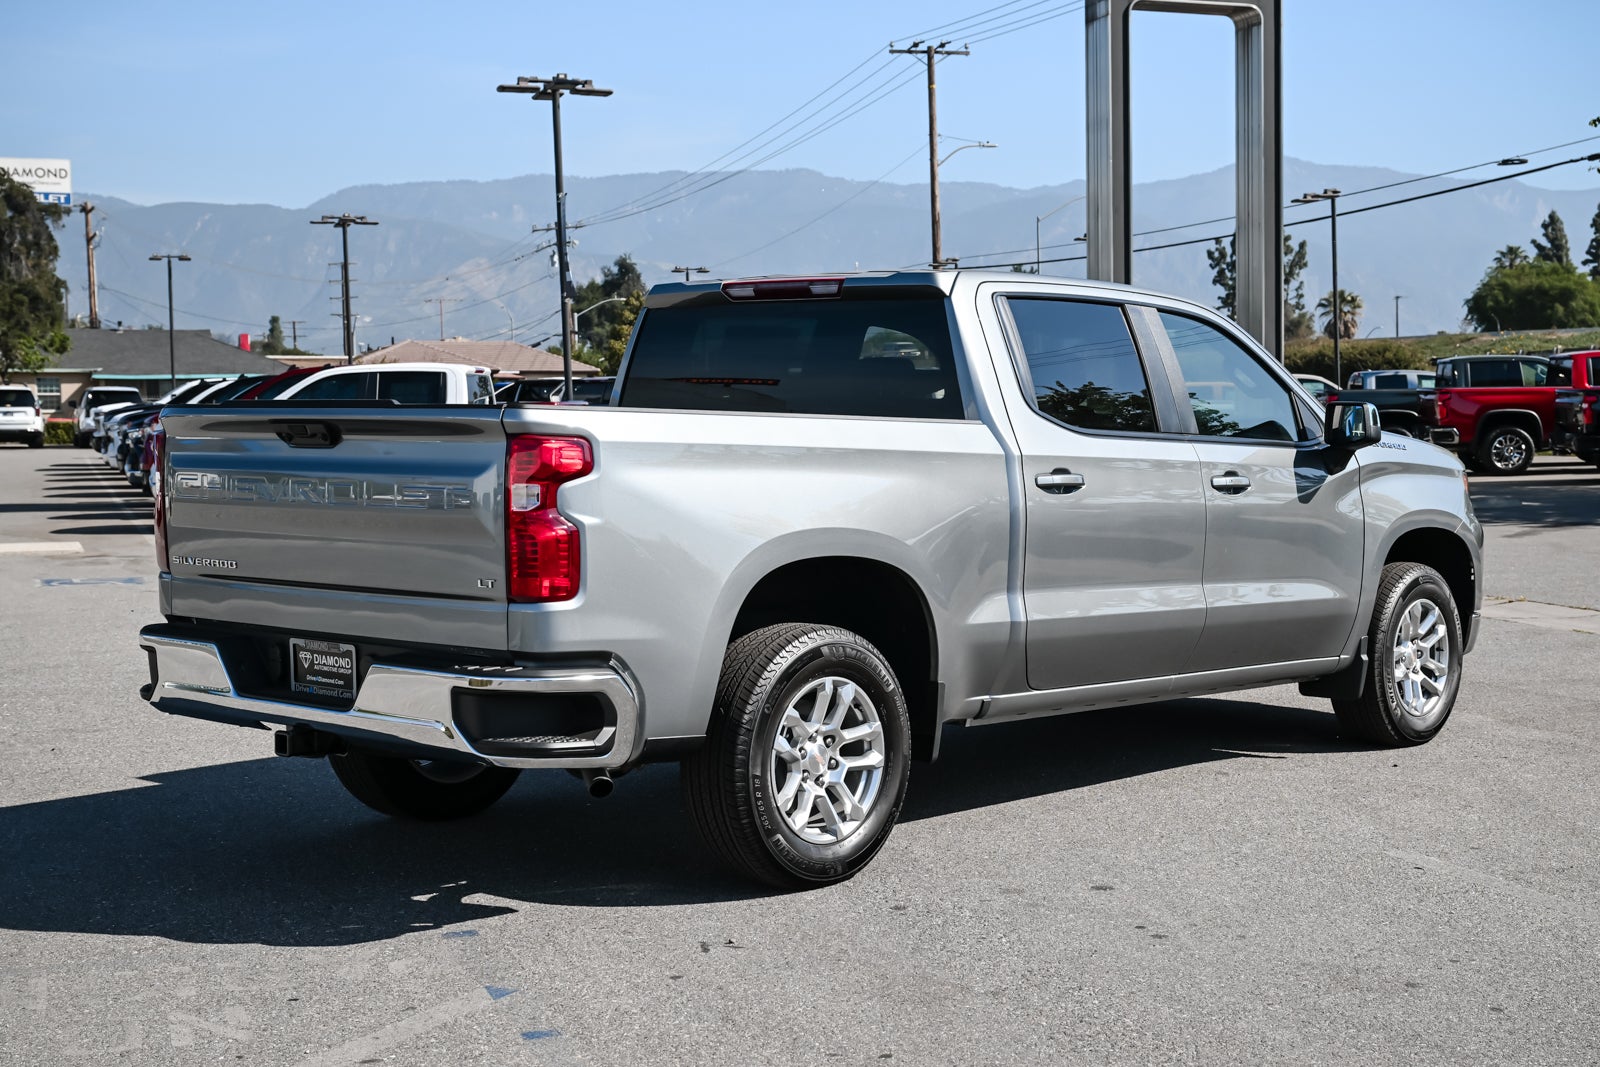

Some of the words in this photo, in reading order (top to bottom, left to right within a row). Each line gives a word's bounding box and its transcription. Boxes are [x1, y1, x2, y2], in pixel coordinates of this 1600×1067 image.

[175, 471, 471, 509] CHEVROLET
[172, 555, 238, 569] SILVERADO
[477, 578, 496, 588] LT
[314, 654, 351, 668] DIAMOND
[845, 646, 893, 689] MICHELIN
[313, 664, 338, 673] AUTOMOTIVE
[338, 667, 352, 675] GROUP
[754, 778, 761, 788] 18
